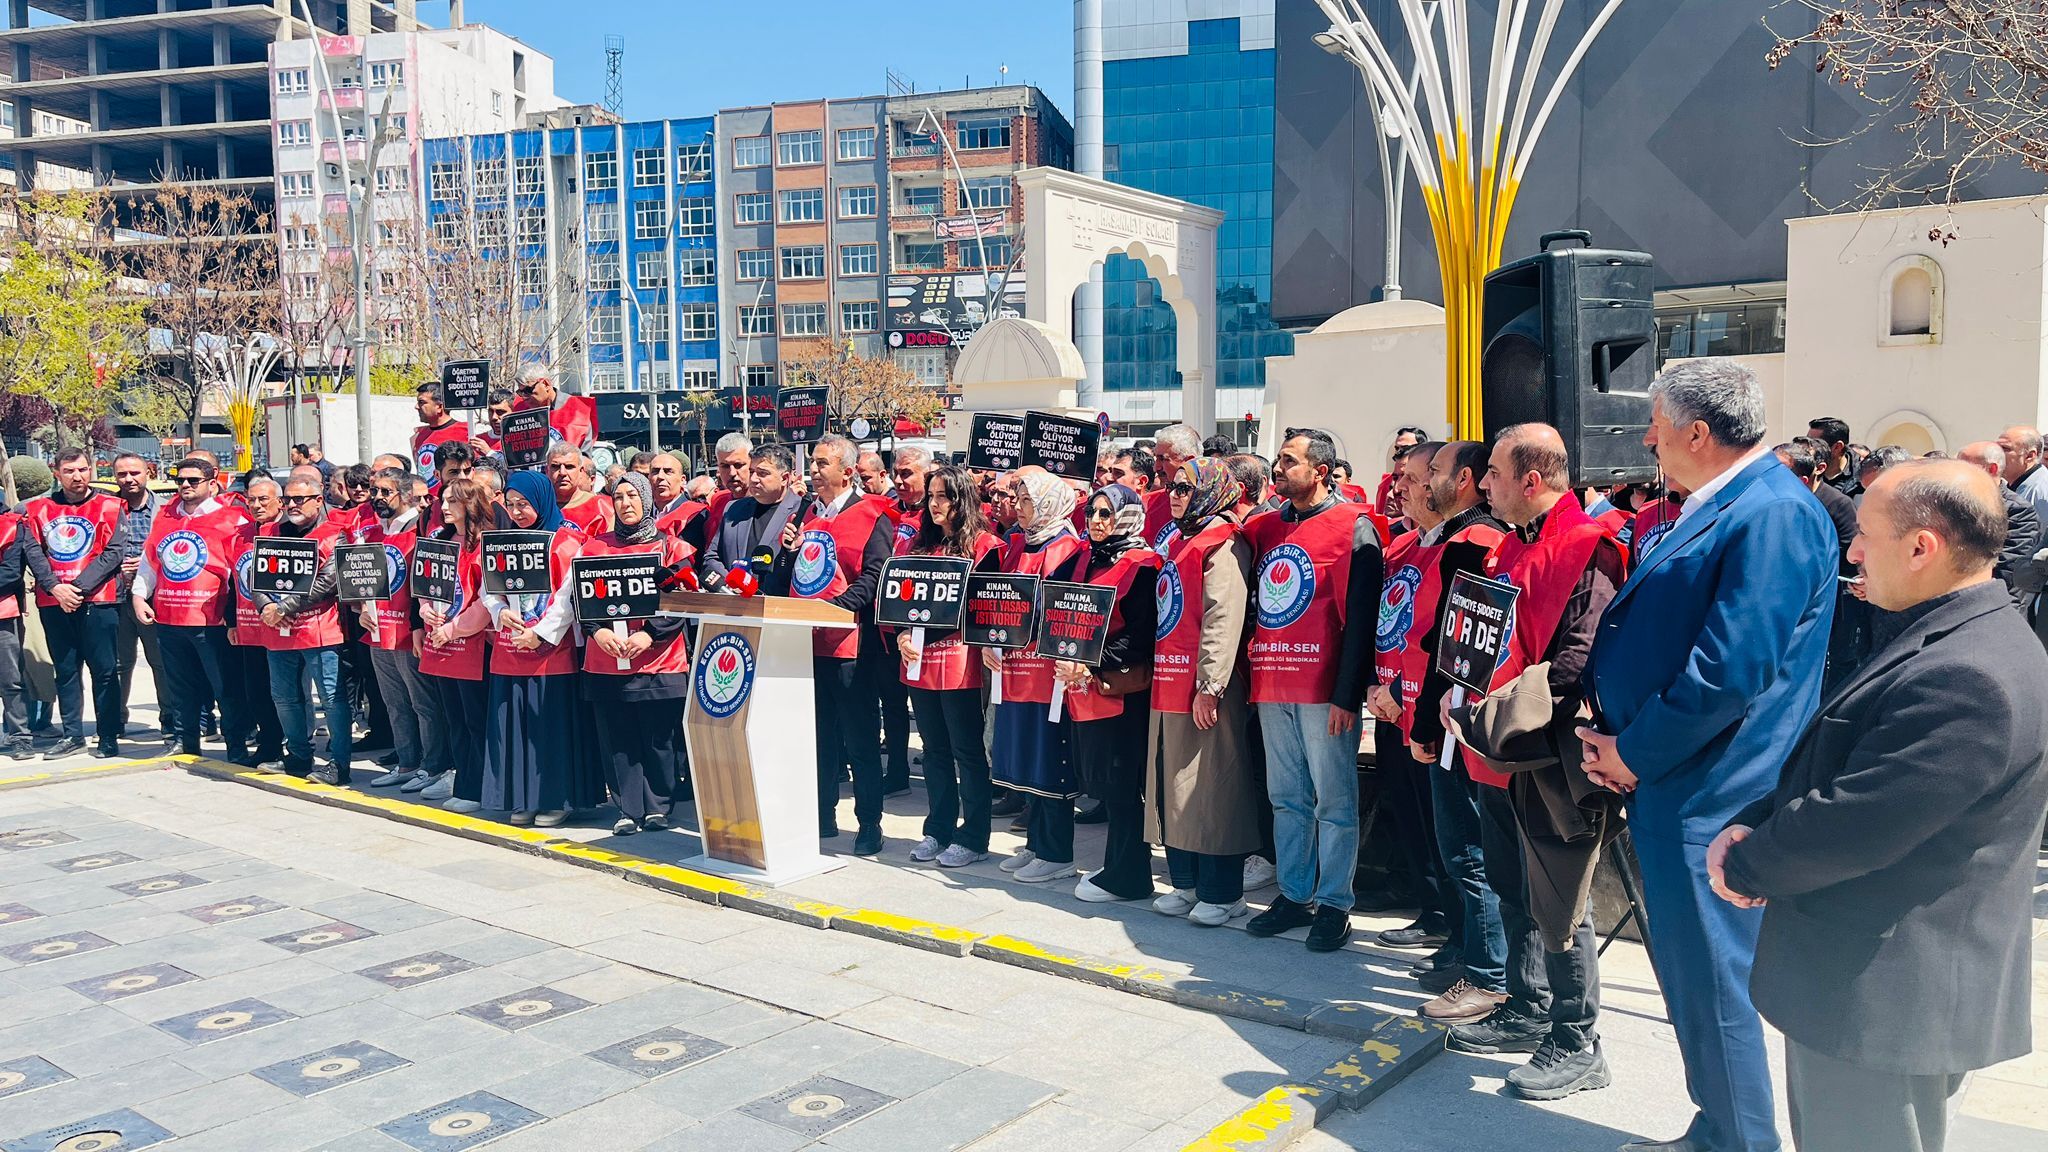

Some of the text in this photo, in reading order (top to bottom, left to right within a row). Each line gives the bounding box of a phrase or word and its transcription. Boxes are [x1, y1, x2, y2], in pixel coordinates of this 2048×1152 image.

[624, 403, 681, 419] SARE
[1038, 421, 1081, 436] ÖĞRETMEN
[990, 431, 1018, 441] ÖLÜYOR
[1042, 432, 1074, 445] ÖLÜYOR
[978, 438, 1022, 449] ŞİDDET YASA
[1030, 438, 1086, 454] ŞİDDET YASASI
[1038, 449, 1076, 462] ÇIKMIYOR
[294, 559, 313, 575] DE
[351, 560, 373, 569] ÖLÜYOR
[522, 552, 545, 570] DE
[442, 564, 455, 581] DE
[580, 566, 655, 578] EĞİTİMCİYE ŞİDDETE
[889, 568, 961, 581] EĞİTİMCİYE ŞİDDETE
[628, 577, 657, 595] DE
[933, 583, 960, 602] DE
[986, 582, 1012, 591] KINAMA
[977, 588, 1021, 600] MESAJI DEĞİL
[1063, 592, 1091, 603] KINAMA
[969, 599, 1030, 613] ŞİDDET YASASI
[1054, 600, 1098, 613] MESAJI DEĞİL
[975, 612, 1023, 627] İSTİYORUZ
[1045, 608, 1105, 627] ŞİDDET YASASI
[1474, 620, 1499, 656] DE
